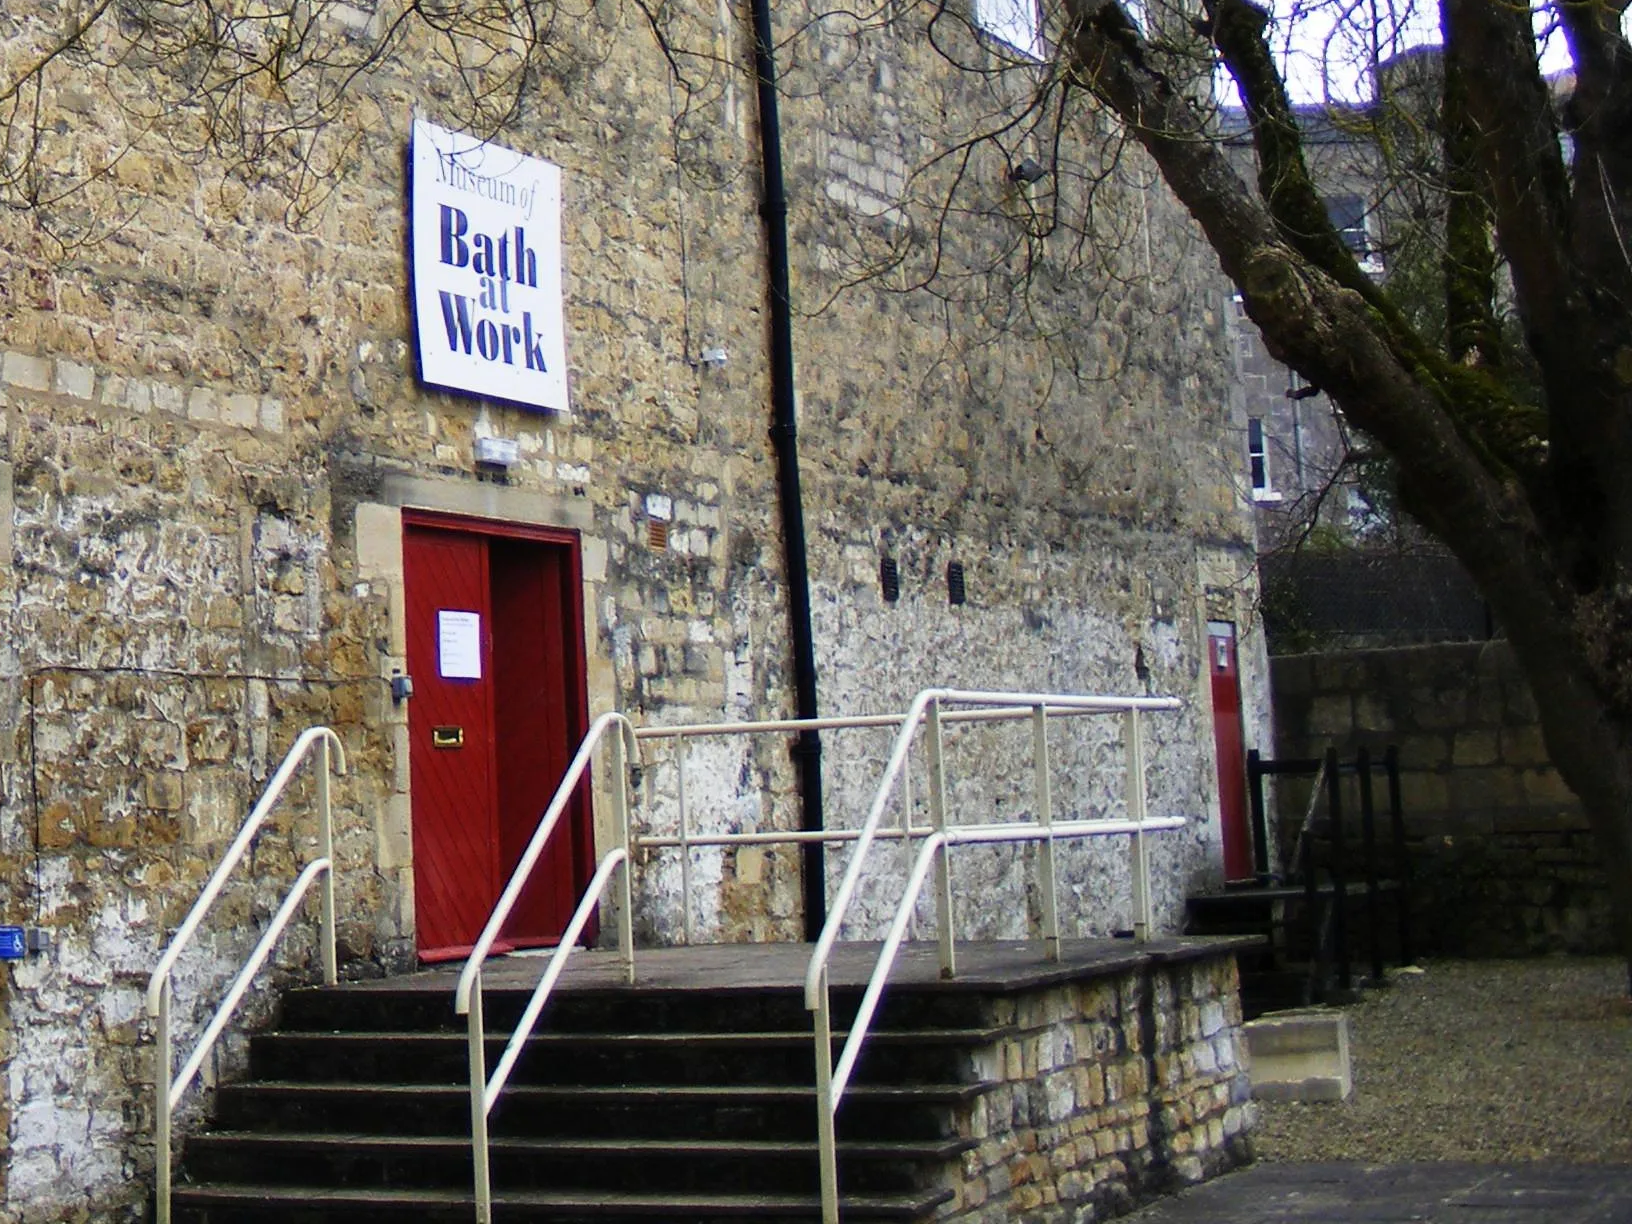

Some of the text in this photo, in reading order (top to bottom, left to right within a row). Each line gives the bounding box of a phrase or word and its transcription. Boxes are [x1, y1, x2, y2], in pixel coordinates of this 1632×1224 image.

[435, 154, 540, 221] Museum of
[437, 203, 539, 289] Bath
[438, 290, 548, 374] Work
[479, 275, 510, 314] at
